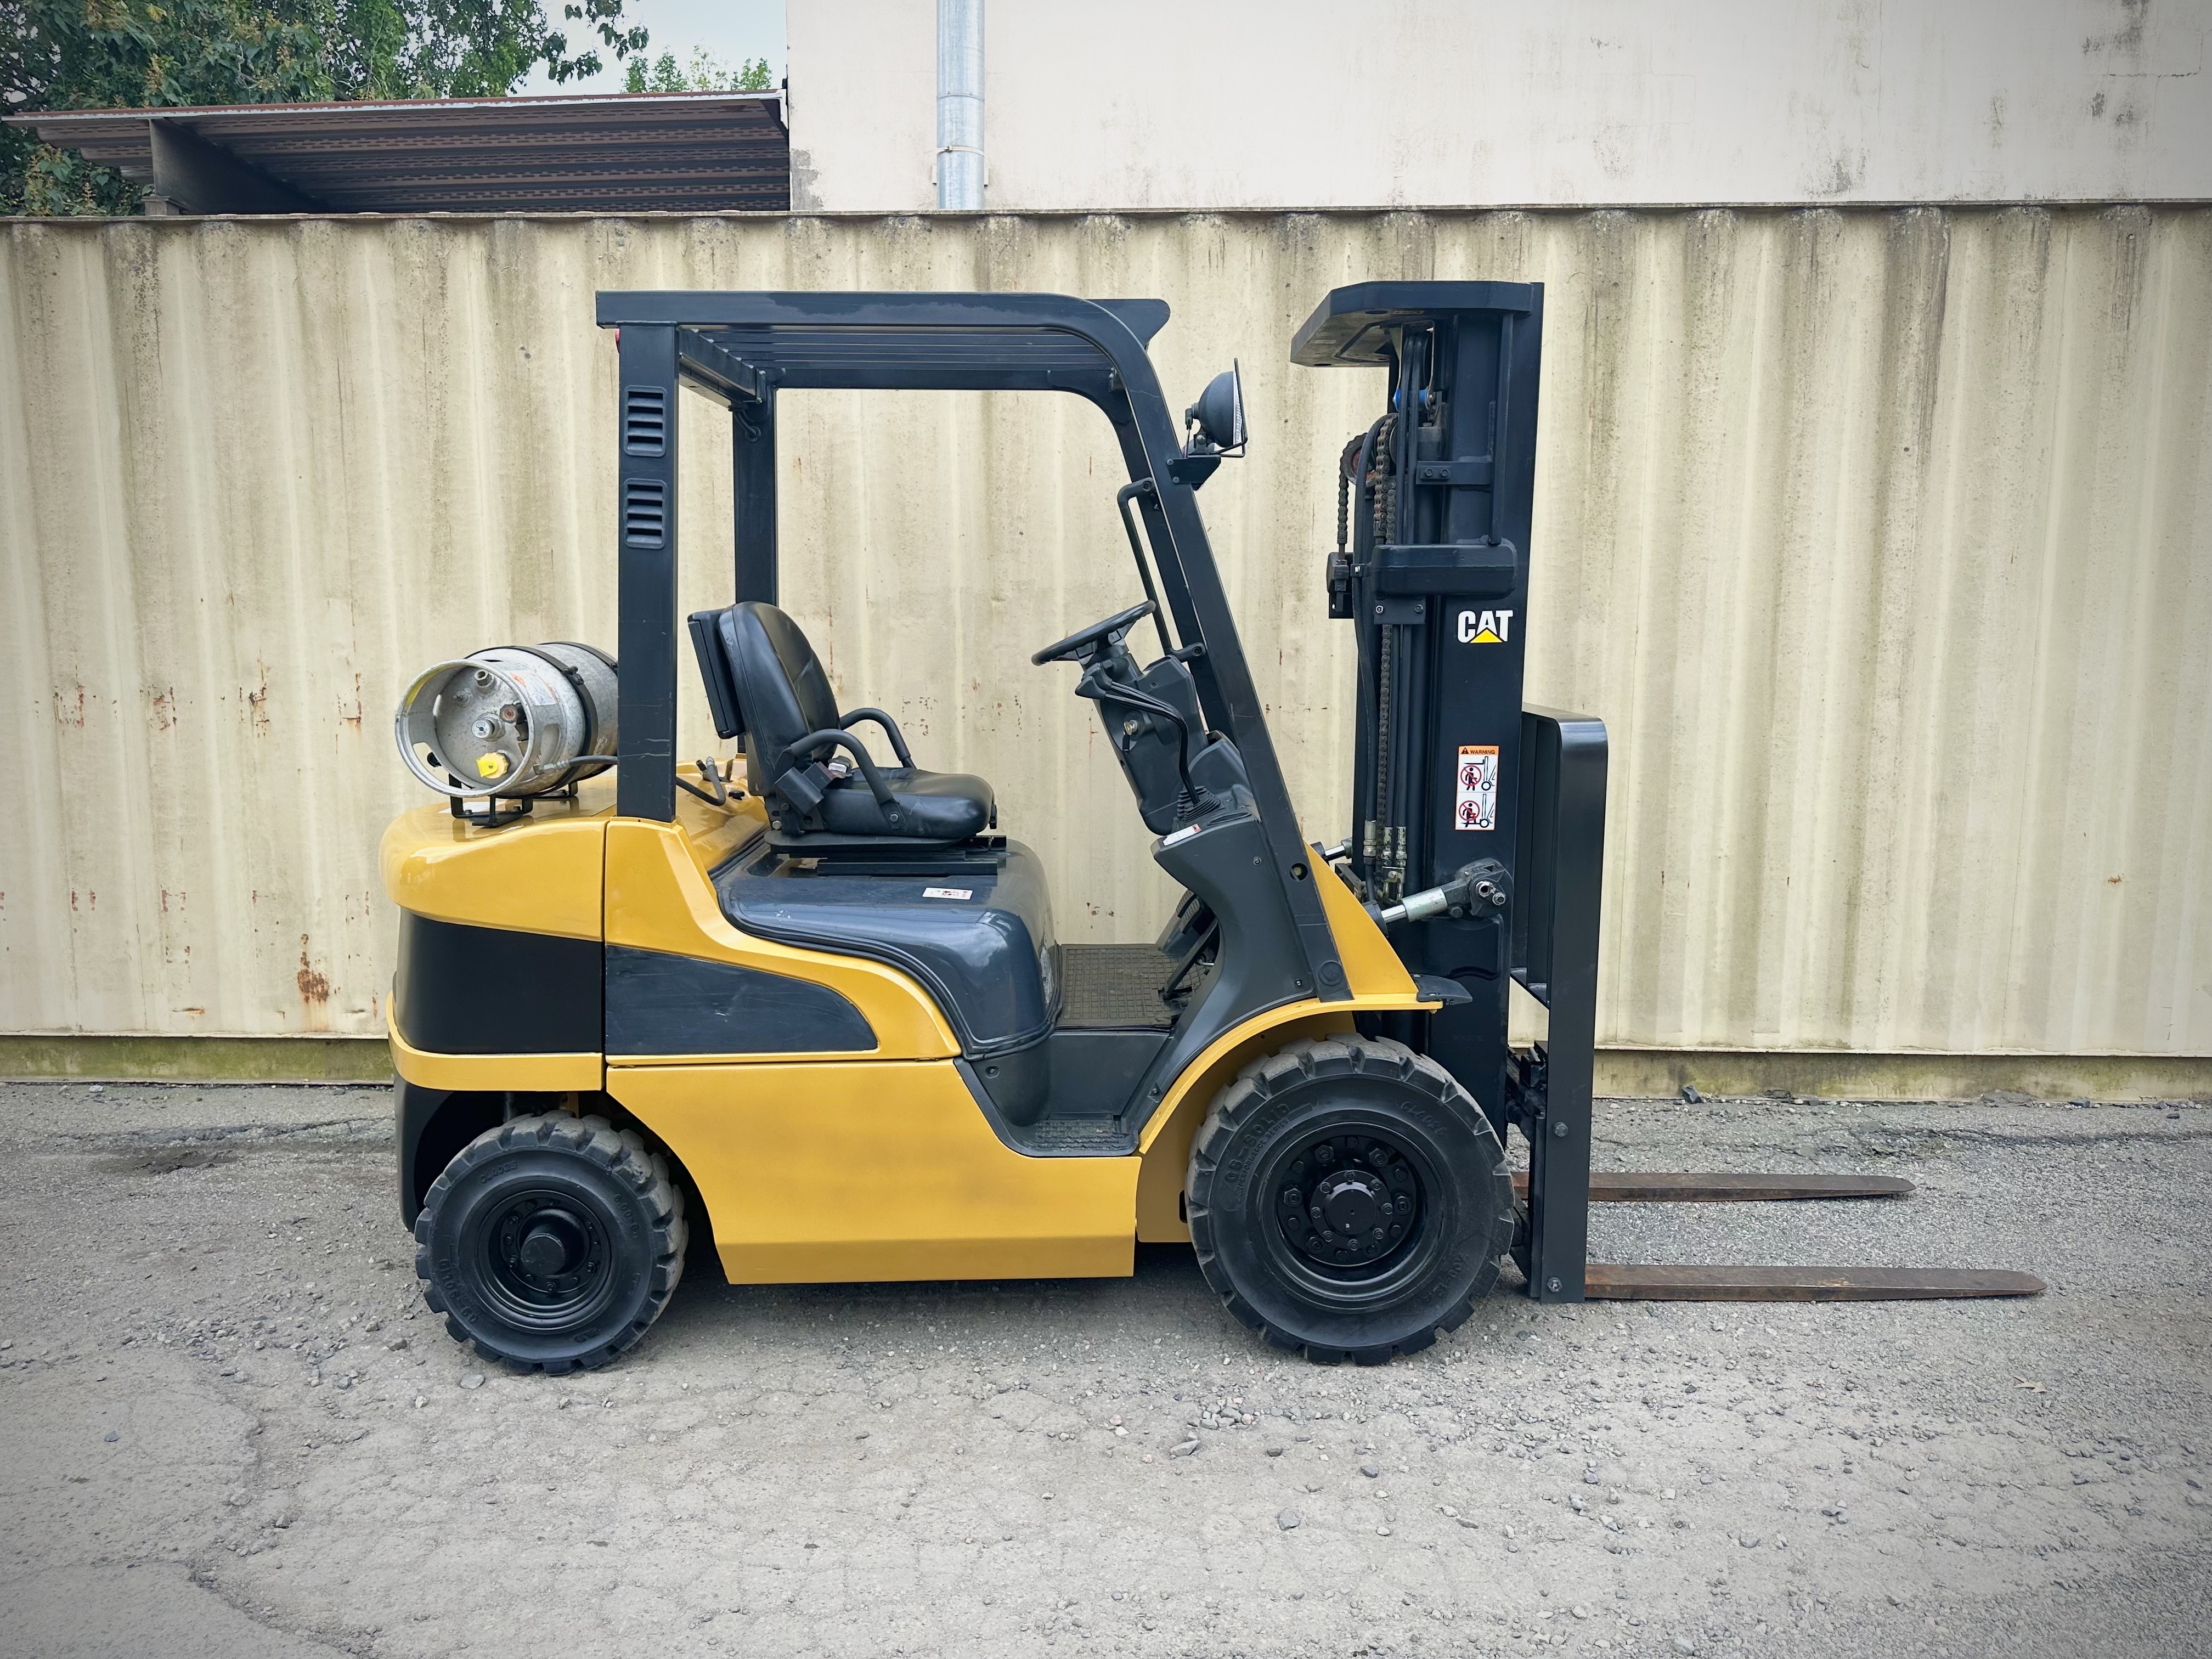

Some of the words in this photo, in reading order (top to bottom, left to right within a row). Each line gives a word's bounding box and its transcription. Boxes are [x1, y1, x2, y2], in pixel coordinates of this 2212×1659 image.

[1457, 610, 1514, 643] CAT
[1238, 1140, 1266, 1187] PERFORMANCE
[1266, 1118, 1289, 1138] SERIES
